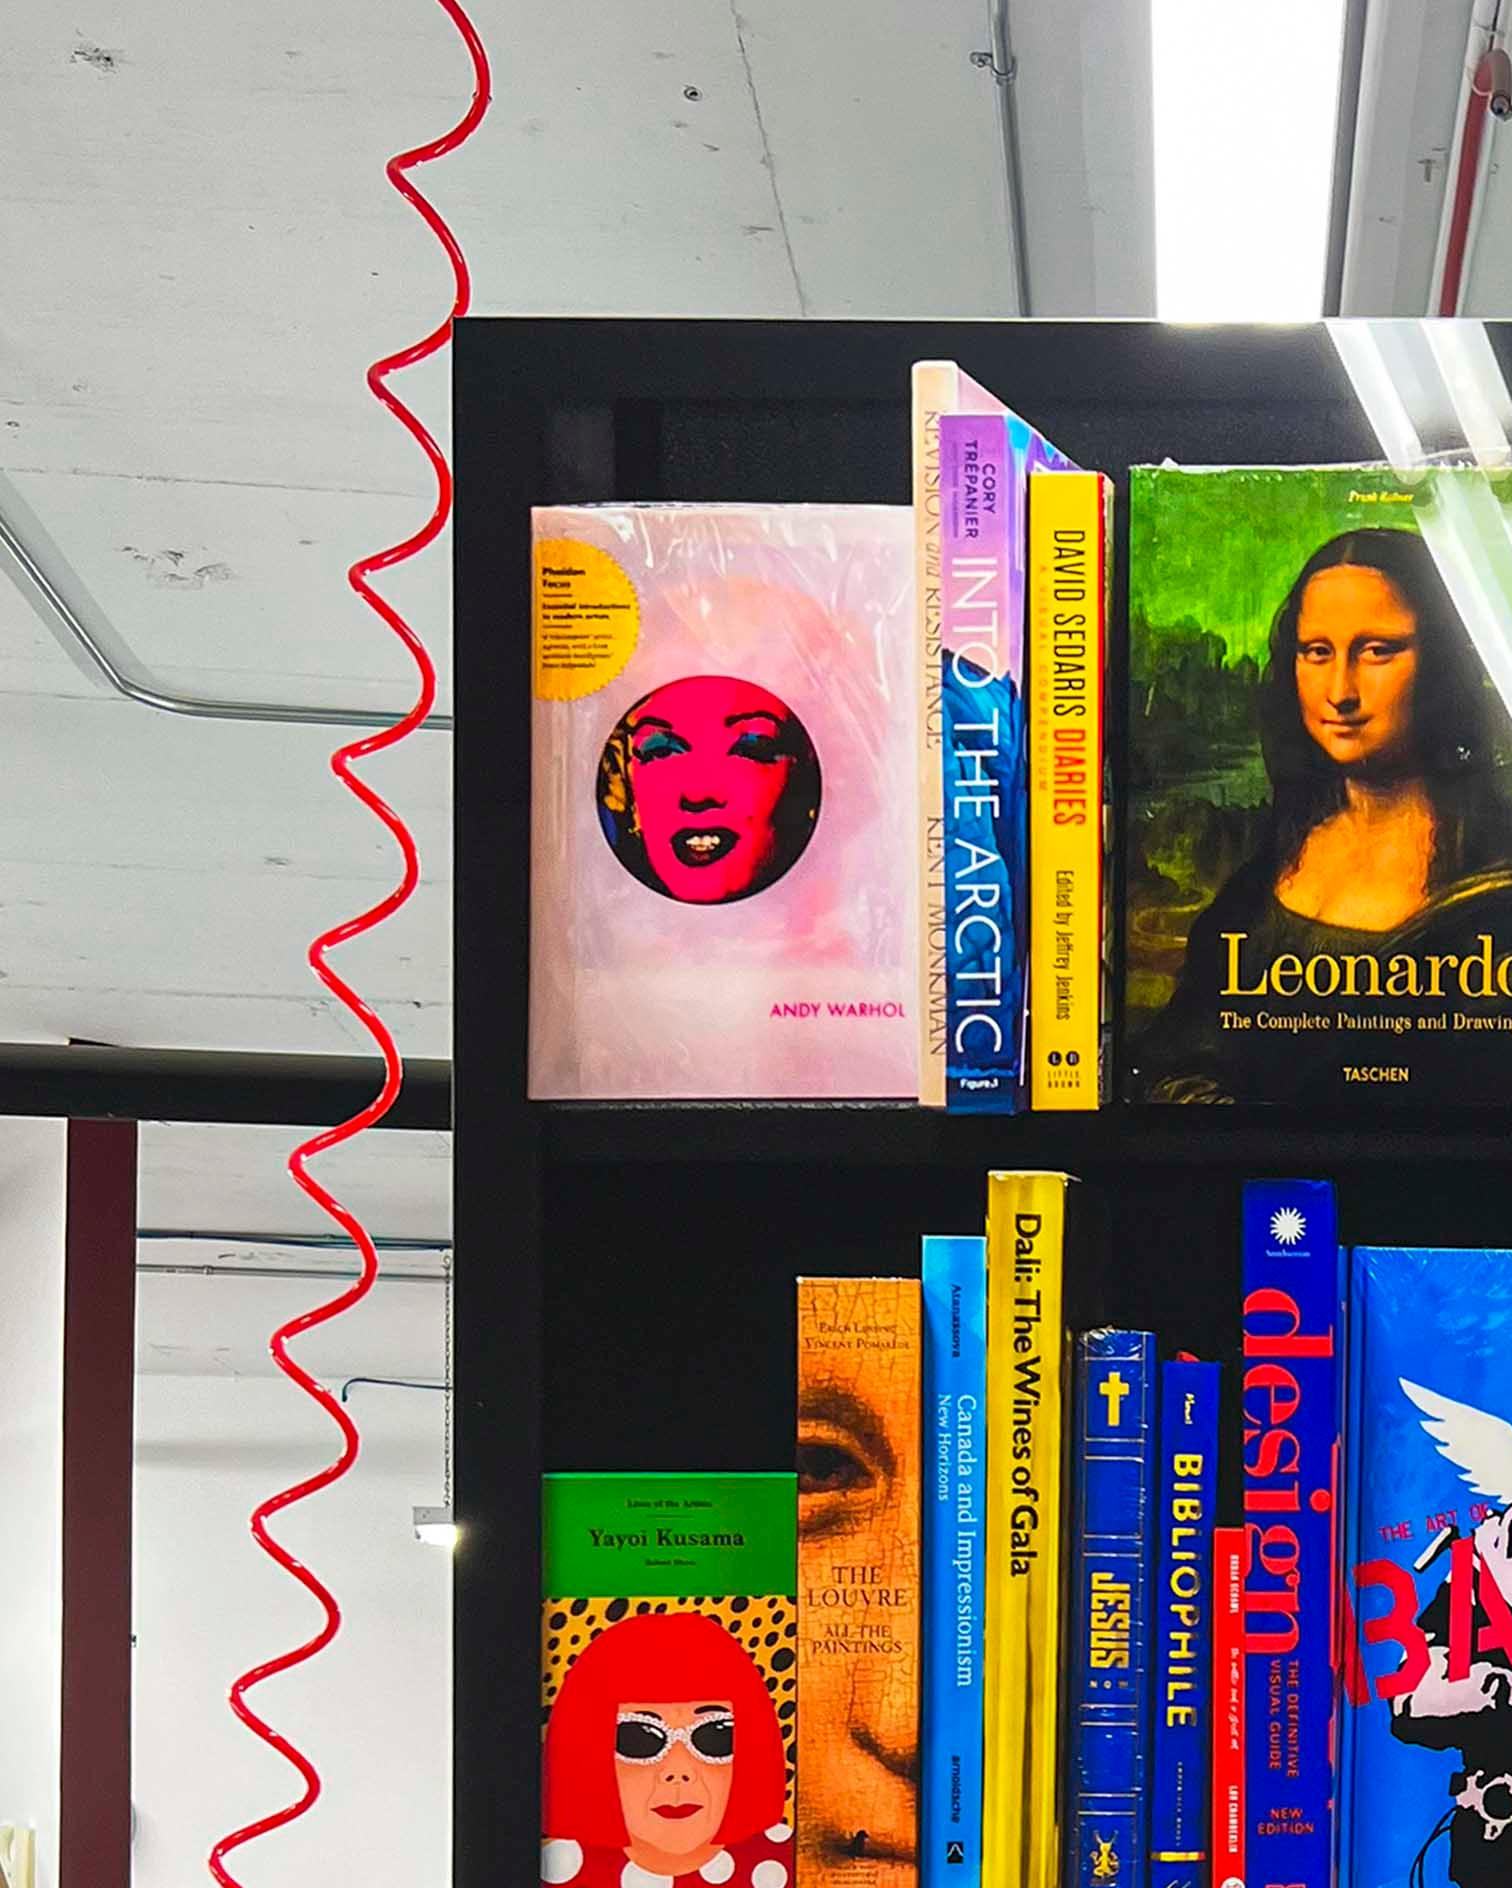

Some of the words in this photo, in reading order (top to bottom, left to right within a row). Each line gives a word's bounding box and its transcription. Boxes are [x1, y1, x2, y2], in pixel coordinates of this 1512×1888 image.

[981, 463, 995, 514] CORY
[1053, 530, 1086, 602] DAVID
[952, 557, 998, 688] INTO
[1053, 614, 1086, 716] SEDARIS
[953, 707, 1000, 818] THE
[1053, 728, 1086, 826] DIARIES
[954, 838, 1002, 1053] ARCTIC
[770, 1003, 821, 1018] ANDY
[828, 1003, 904, 1018] WARHOL
[1220, 1011, 1252, 1030] The
[1257, 1011, 1330, 1033] Complete
[1337, 1011, 1411, 1033] Paintings
[1418, 1012, 1447, 1030] and
[1343, 1068, 1409, 1082] TASCHEN
[1014, 1289, 1040, 1353] The
[939, 1394, 951, 1425] New
[1012, 1357, 1040, 1459] Wines
[957, 1395, 977, 1473] Canada
[939, 1431, 951, 1501] Horizons
[1012, 1465, 1040, 1501] of
[1243, 1288, 1334, 1654] design
[957, 1480, 977, 1522] and
[589, 1529, 647, 1550] Yayoi
[657, 1528, 744, 1546] Kusama
[1010, 1508, 1039, 1577] Gala
[1380, 1523, 1416, 1543] THE
[1425, 1513, 1458, 1532] ART
[809, 1588, 906, 1608] LOUVRE
[832, 1566, 882, 1585] THE
[1167, 1454, 1203, 1728] BIBLIOPHILE
[823, 1625, 850, 1638] ALL
[858, 1625, 891, 1638] THE
[952, 1531, 977, 1687] Impressionism
[812, 1640, 902, 1654] PAINTINGS
[1269, 1660, 1280, 1715] VISUAL
[1288, 1660, 1299, 1686] THE
[1269, 1722, 1280, 1770] GUIDE
[1287, 1691, 1299, 1778] DEFINITIVE
[1258, 1823, 1314, 1834] EDITION
[1270, 1808, 1303, 1819] NEW
